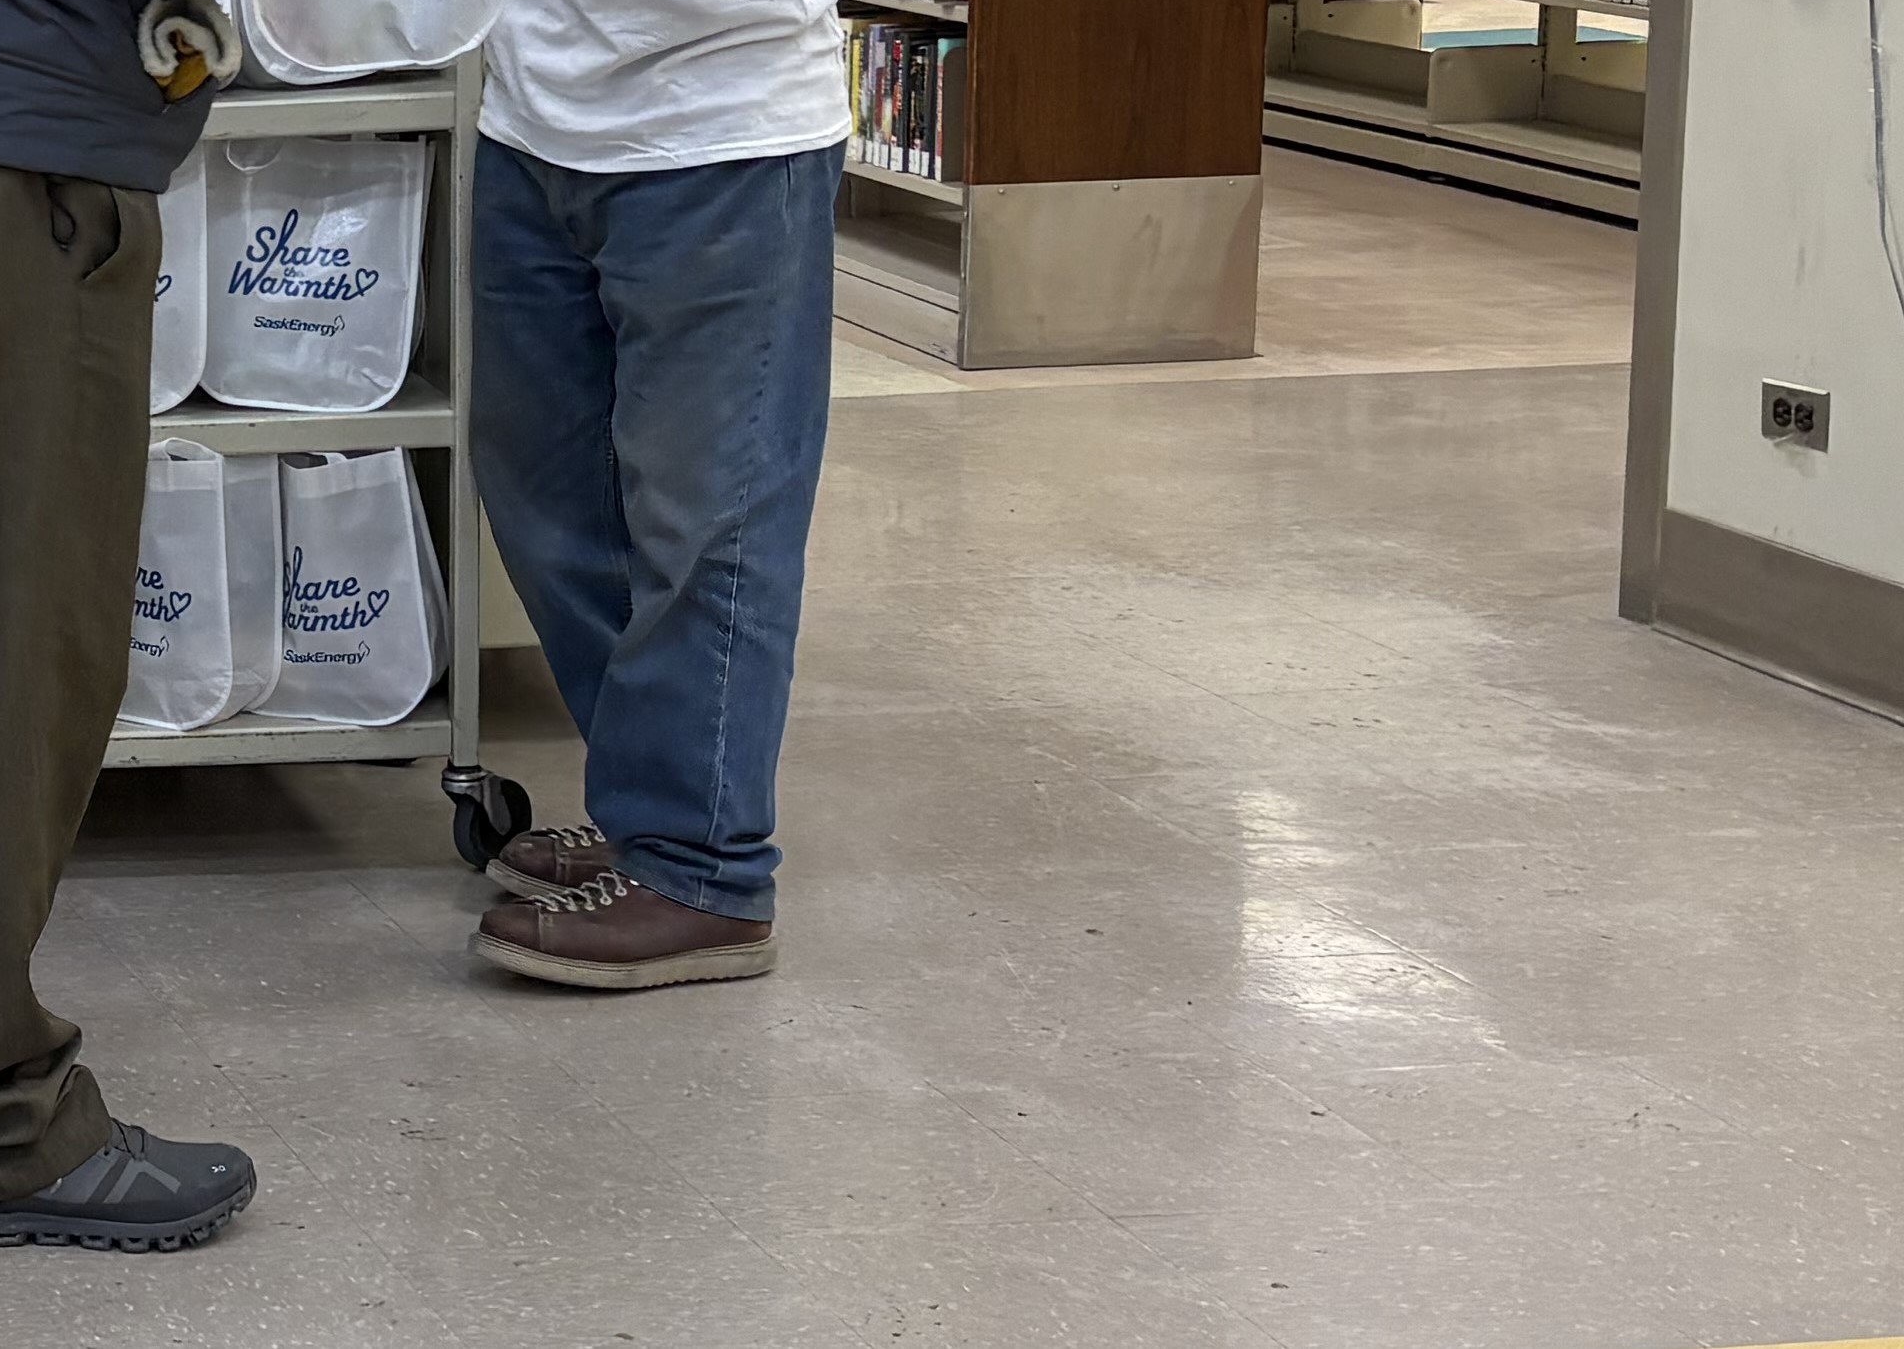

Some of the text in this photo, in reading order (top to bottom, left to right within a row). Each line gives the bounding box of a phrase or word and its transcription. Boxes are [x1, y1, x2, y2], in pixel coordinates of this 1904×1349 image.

[246, 209, 351, 267] Share
[228, 260, 354, 301] Warmth
[253, 315, 339, 337] SaskEnergy
[130, 636, 166, 657] Energy
[283, 647, 366, 665] SaskEnergy
